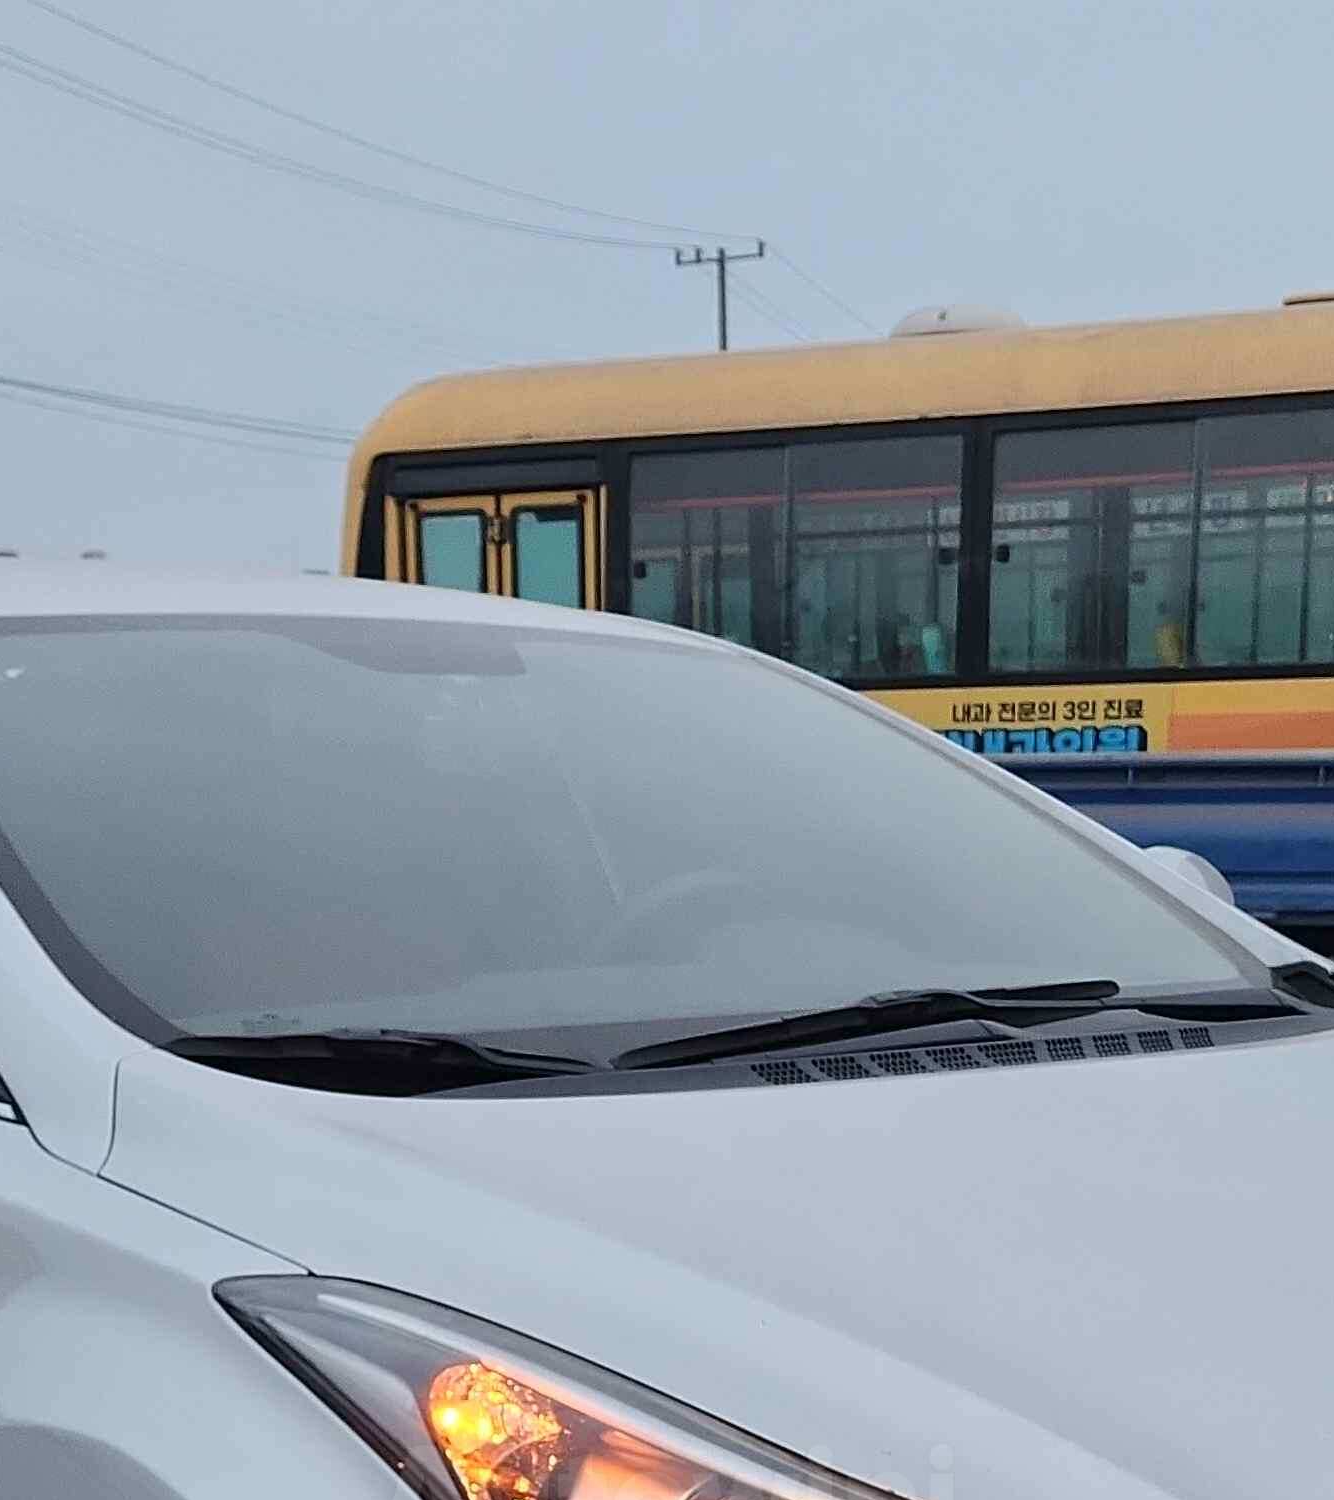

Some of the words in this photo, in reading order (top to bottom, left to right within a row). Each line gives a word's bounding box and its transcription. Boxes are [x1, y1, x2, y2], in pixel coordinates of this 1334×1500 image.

[952, 702, 992, 723] 내과
[998, 700, 1057, 723] 전문의
[1063, 699, 1097, 721] 3인
[1103, 698, 1144, 720] 진료
